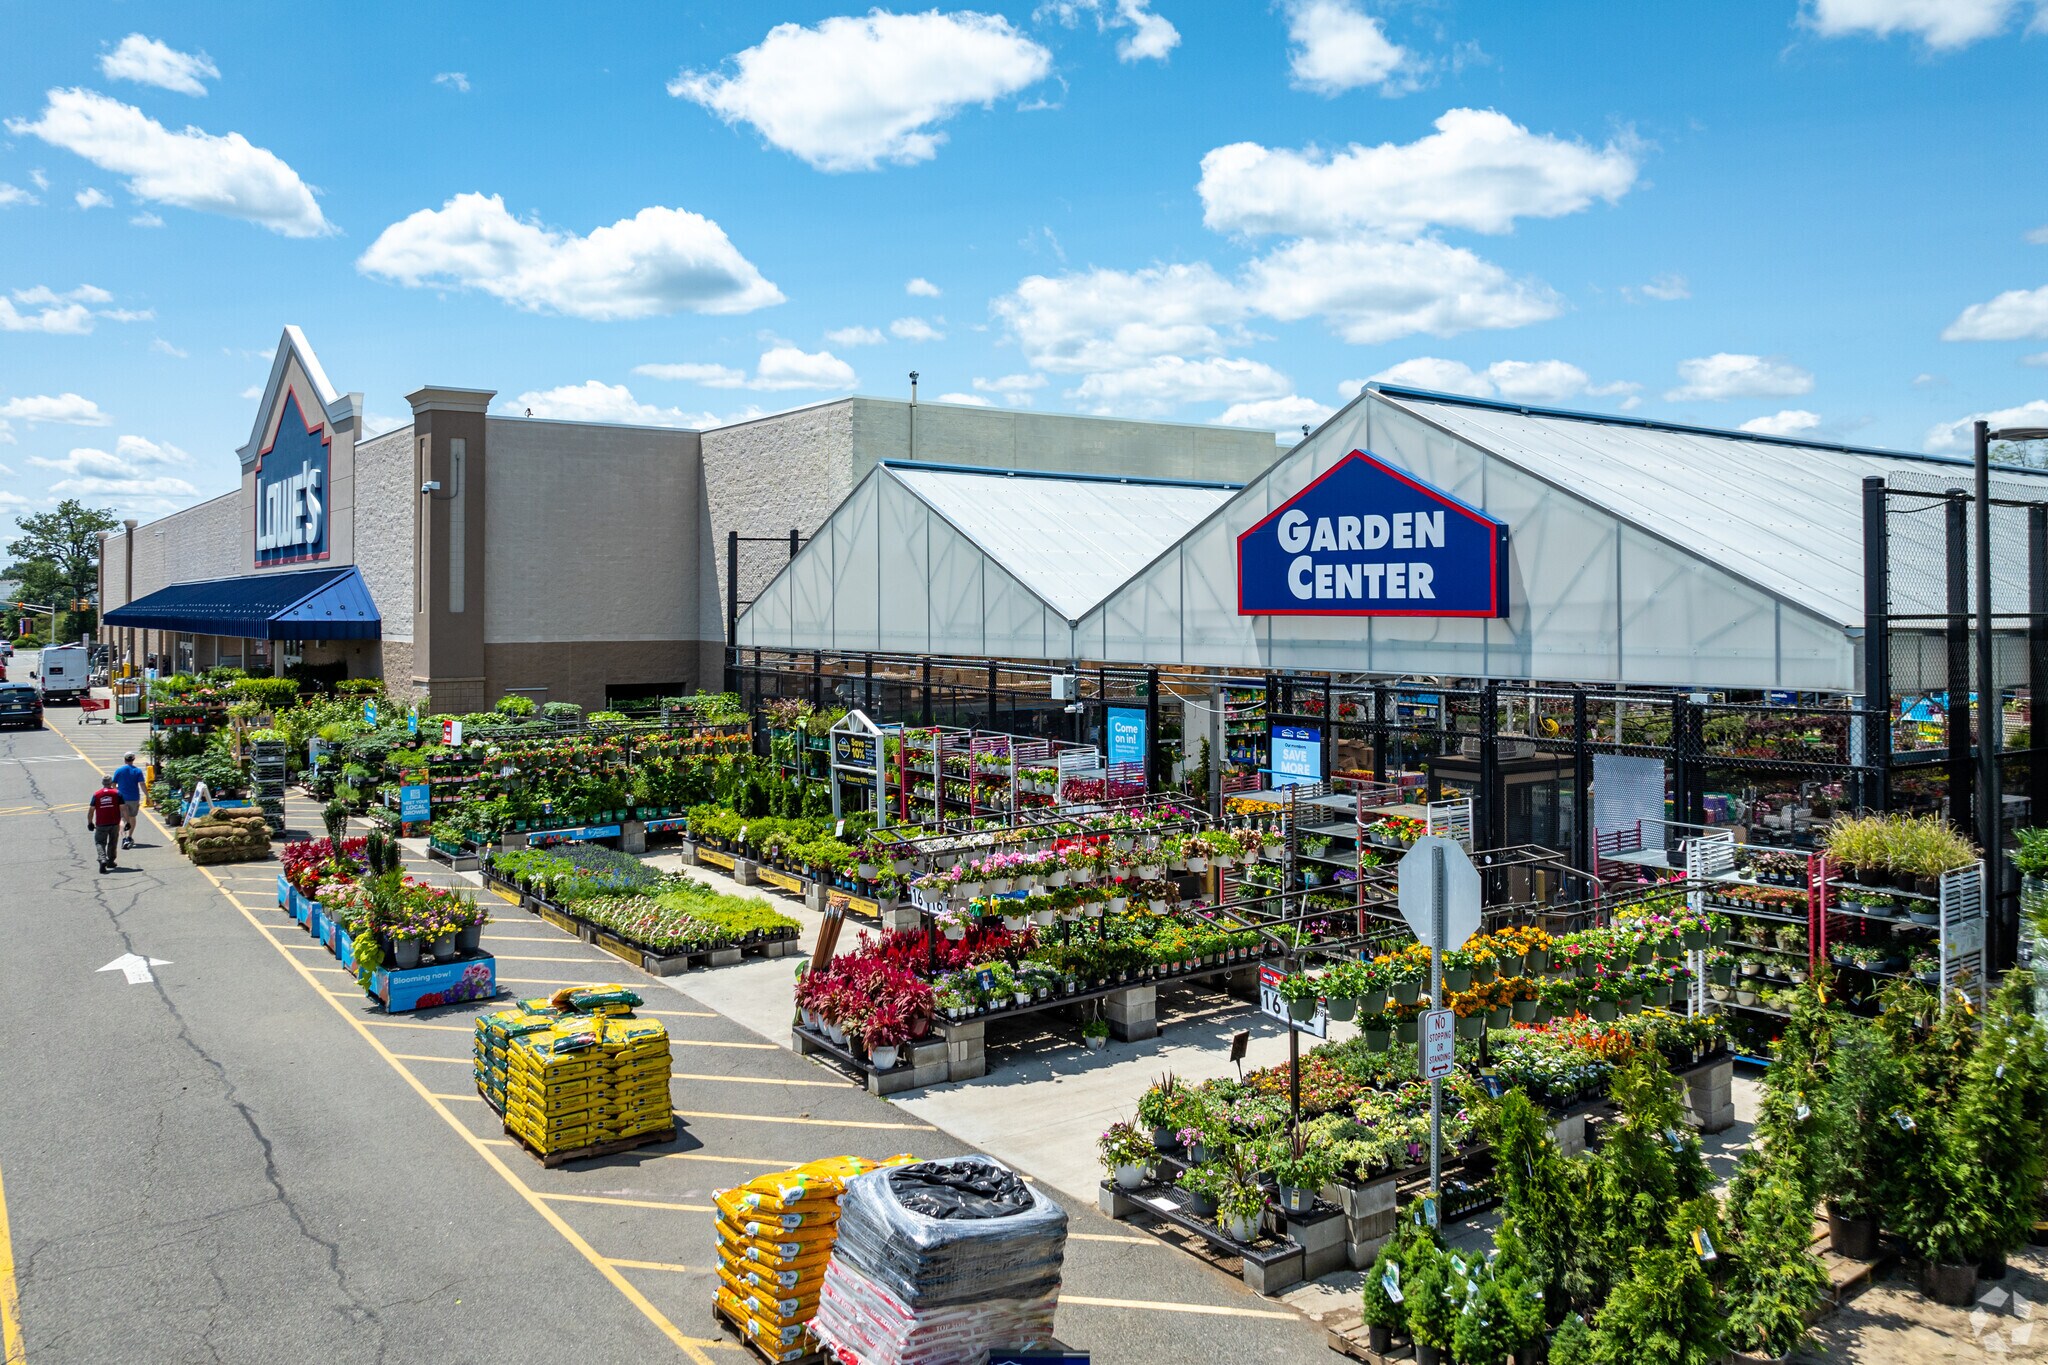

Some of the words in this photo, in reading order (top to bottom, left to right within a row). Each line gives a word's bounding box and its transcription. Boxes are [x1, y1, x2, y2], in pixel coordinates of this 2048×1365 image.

[257, 460, 322, 551] LOWE'S
[1277, 509, 1445, 553] GARDEN
[1287, 555, 1436, 600] CENTER
[1115, 722, 1138, 734] Come
[851, 738, 865, 748] Save
[1115, 735, 1125, 743] on
[1126, 733, 1137, 744] in!
[852, 747, 865, 760] 10%
[1282, 749, 1307, 762] SAVE
[1281, 761, 1310, 775] MORE
[913, 889, 923, 906] 16
[394, 974, 430, 984] Blooming
[432, 971, 451, 979] now!
[1263, 990, 1281, 1014] 16
[1435, 1017, 1446, 1030] NO
[1429, 1030, 1451, 1042] STOPPING
[1437, 1043, 1443, 1052] OR
[1429, 1052, 1451, 1064] STANDING
